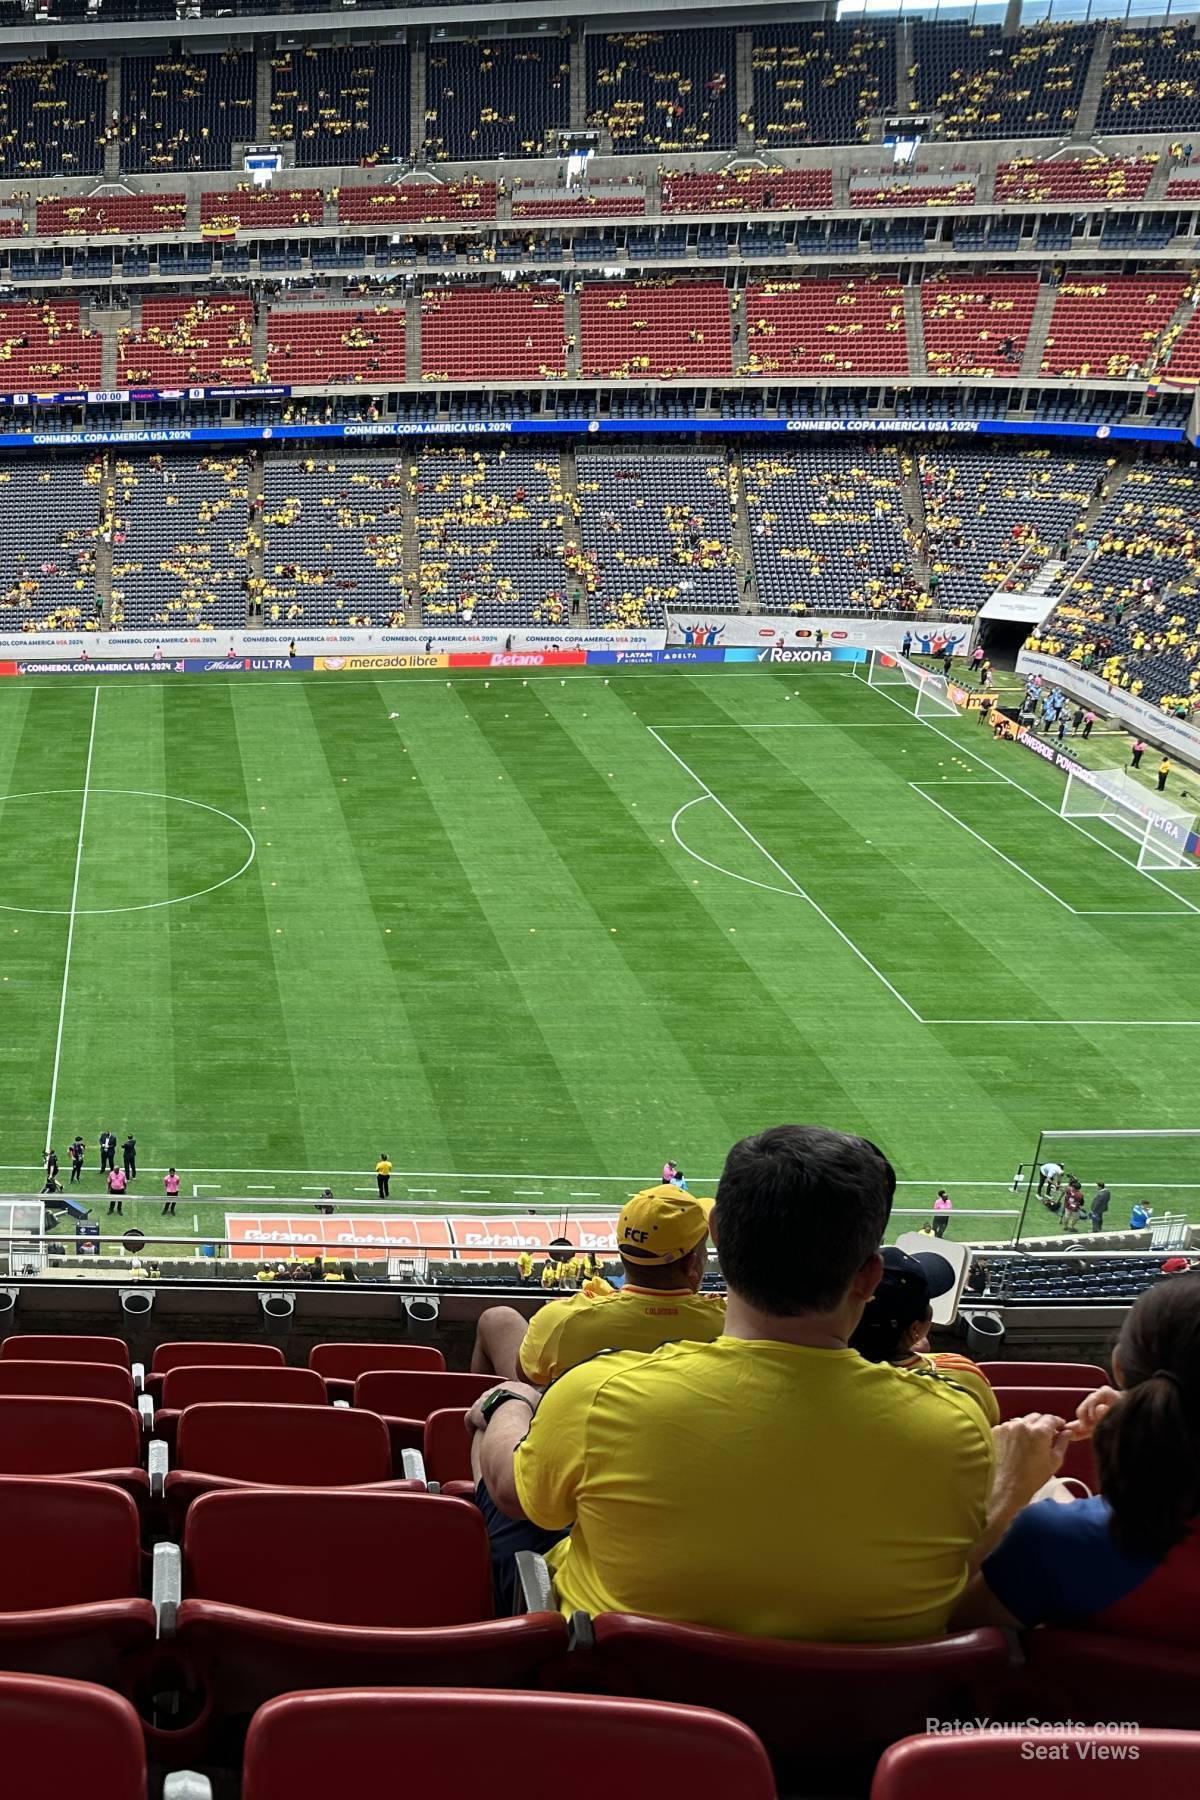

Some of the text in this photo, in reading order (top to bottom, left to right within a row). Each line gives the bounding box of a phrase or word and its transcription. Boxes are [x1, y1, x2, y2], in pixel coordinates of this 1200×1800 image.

[343, 422, 512, 435] CONMEBOL COPA AMERICA USA 2024
[786, 420, 978, 432] CONMEBOL COPA AMERICA USA 2024
[33, 430, 191, 444] CONMEBOL COPA AMERICA USA 2024
[490, 654, 544, 666] Betano
[770, 648, 832, 662] Rexona
[27, 664, 72, 672] CONMEBOL
[72, 664, 96, 672] COPA
[96, 663, 132, 671] AMERICA
[134, 663, 150, 671] USA
[205, 659, 292, 670] Michelob ULTRA
[350, 656, 438, 668] mercado libre
[1018, 730, 1054, 761] POWERADE
[244, 1229, 317, 1242] Betano
[337, 1233, 411, 1244] Betano
[465, 1233, 541, 1247] Betano
[625, 1227, 648, 1243] FCF
